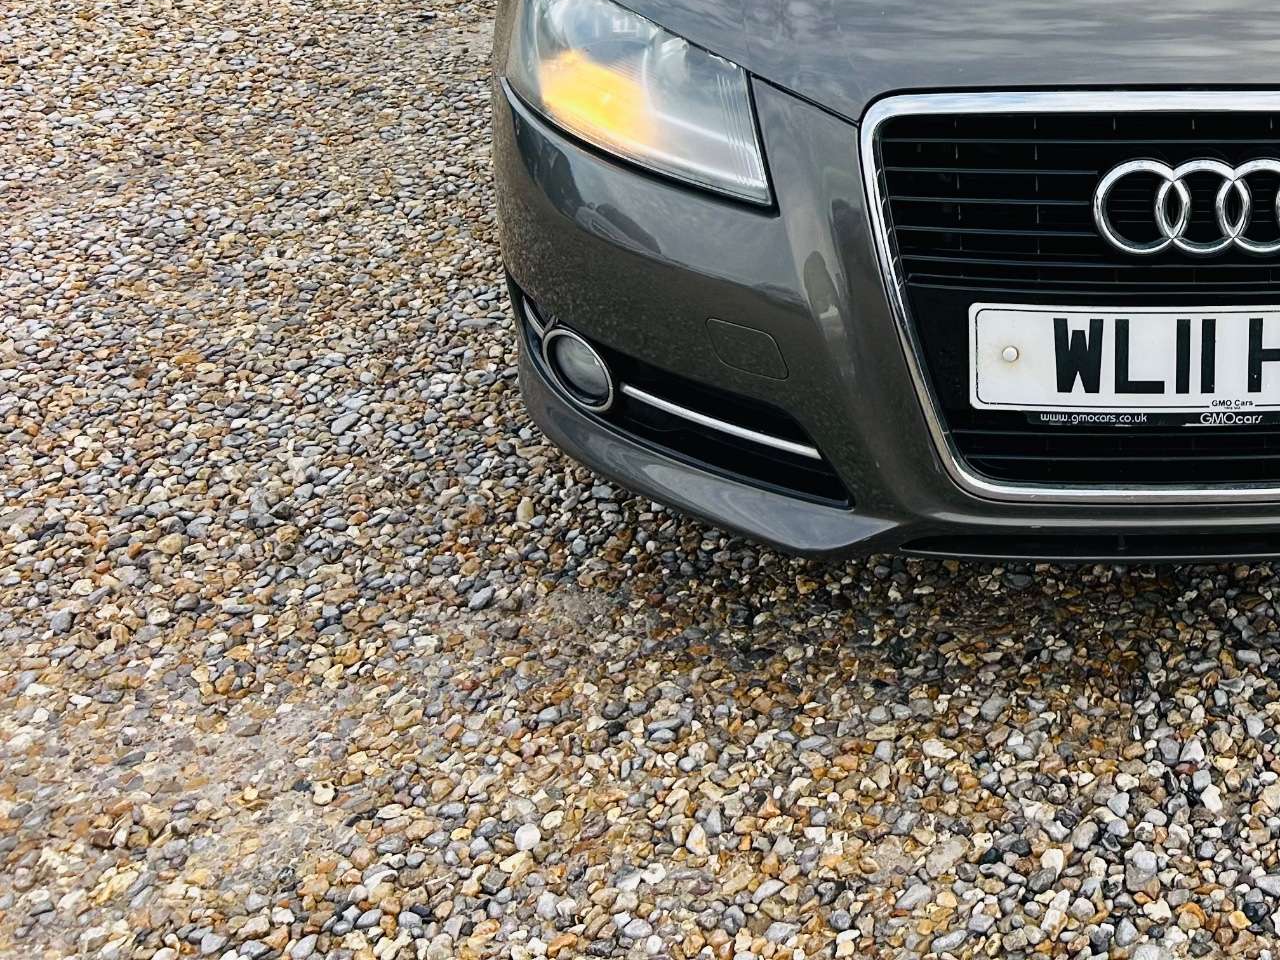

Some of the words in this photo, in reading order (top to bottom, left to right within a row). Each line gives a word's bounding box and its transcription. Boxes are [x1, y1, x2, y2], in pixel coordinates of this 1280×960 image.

[1053, 317, 1217, 394] WL11
[1211, 399, 1232, 407] GMO
[1234, 399, 1254, 407] Cars
[1040, 412, 1148, 425] www.gmocars.co.uk
[1200, 412, 1263, 425] GMOcars
